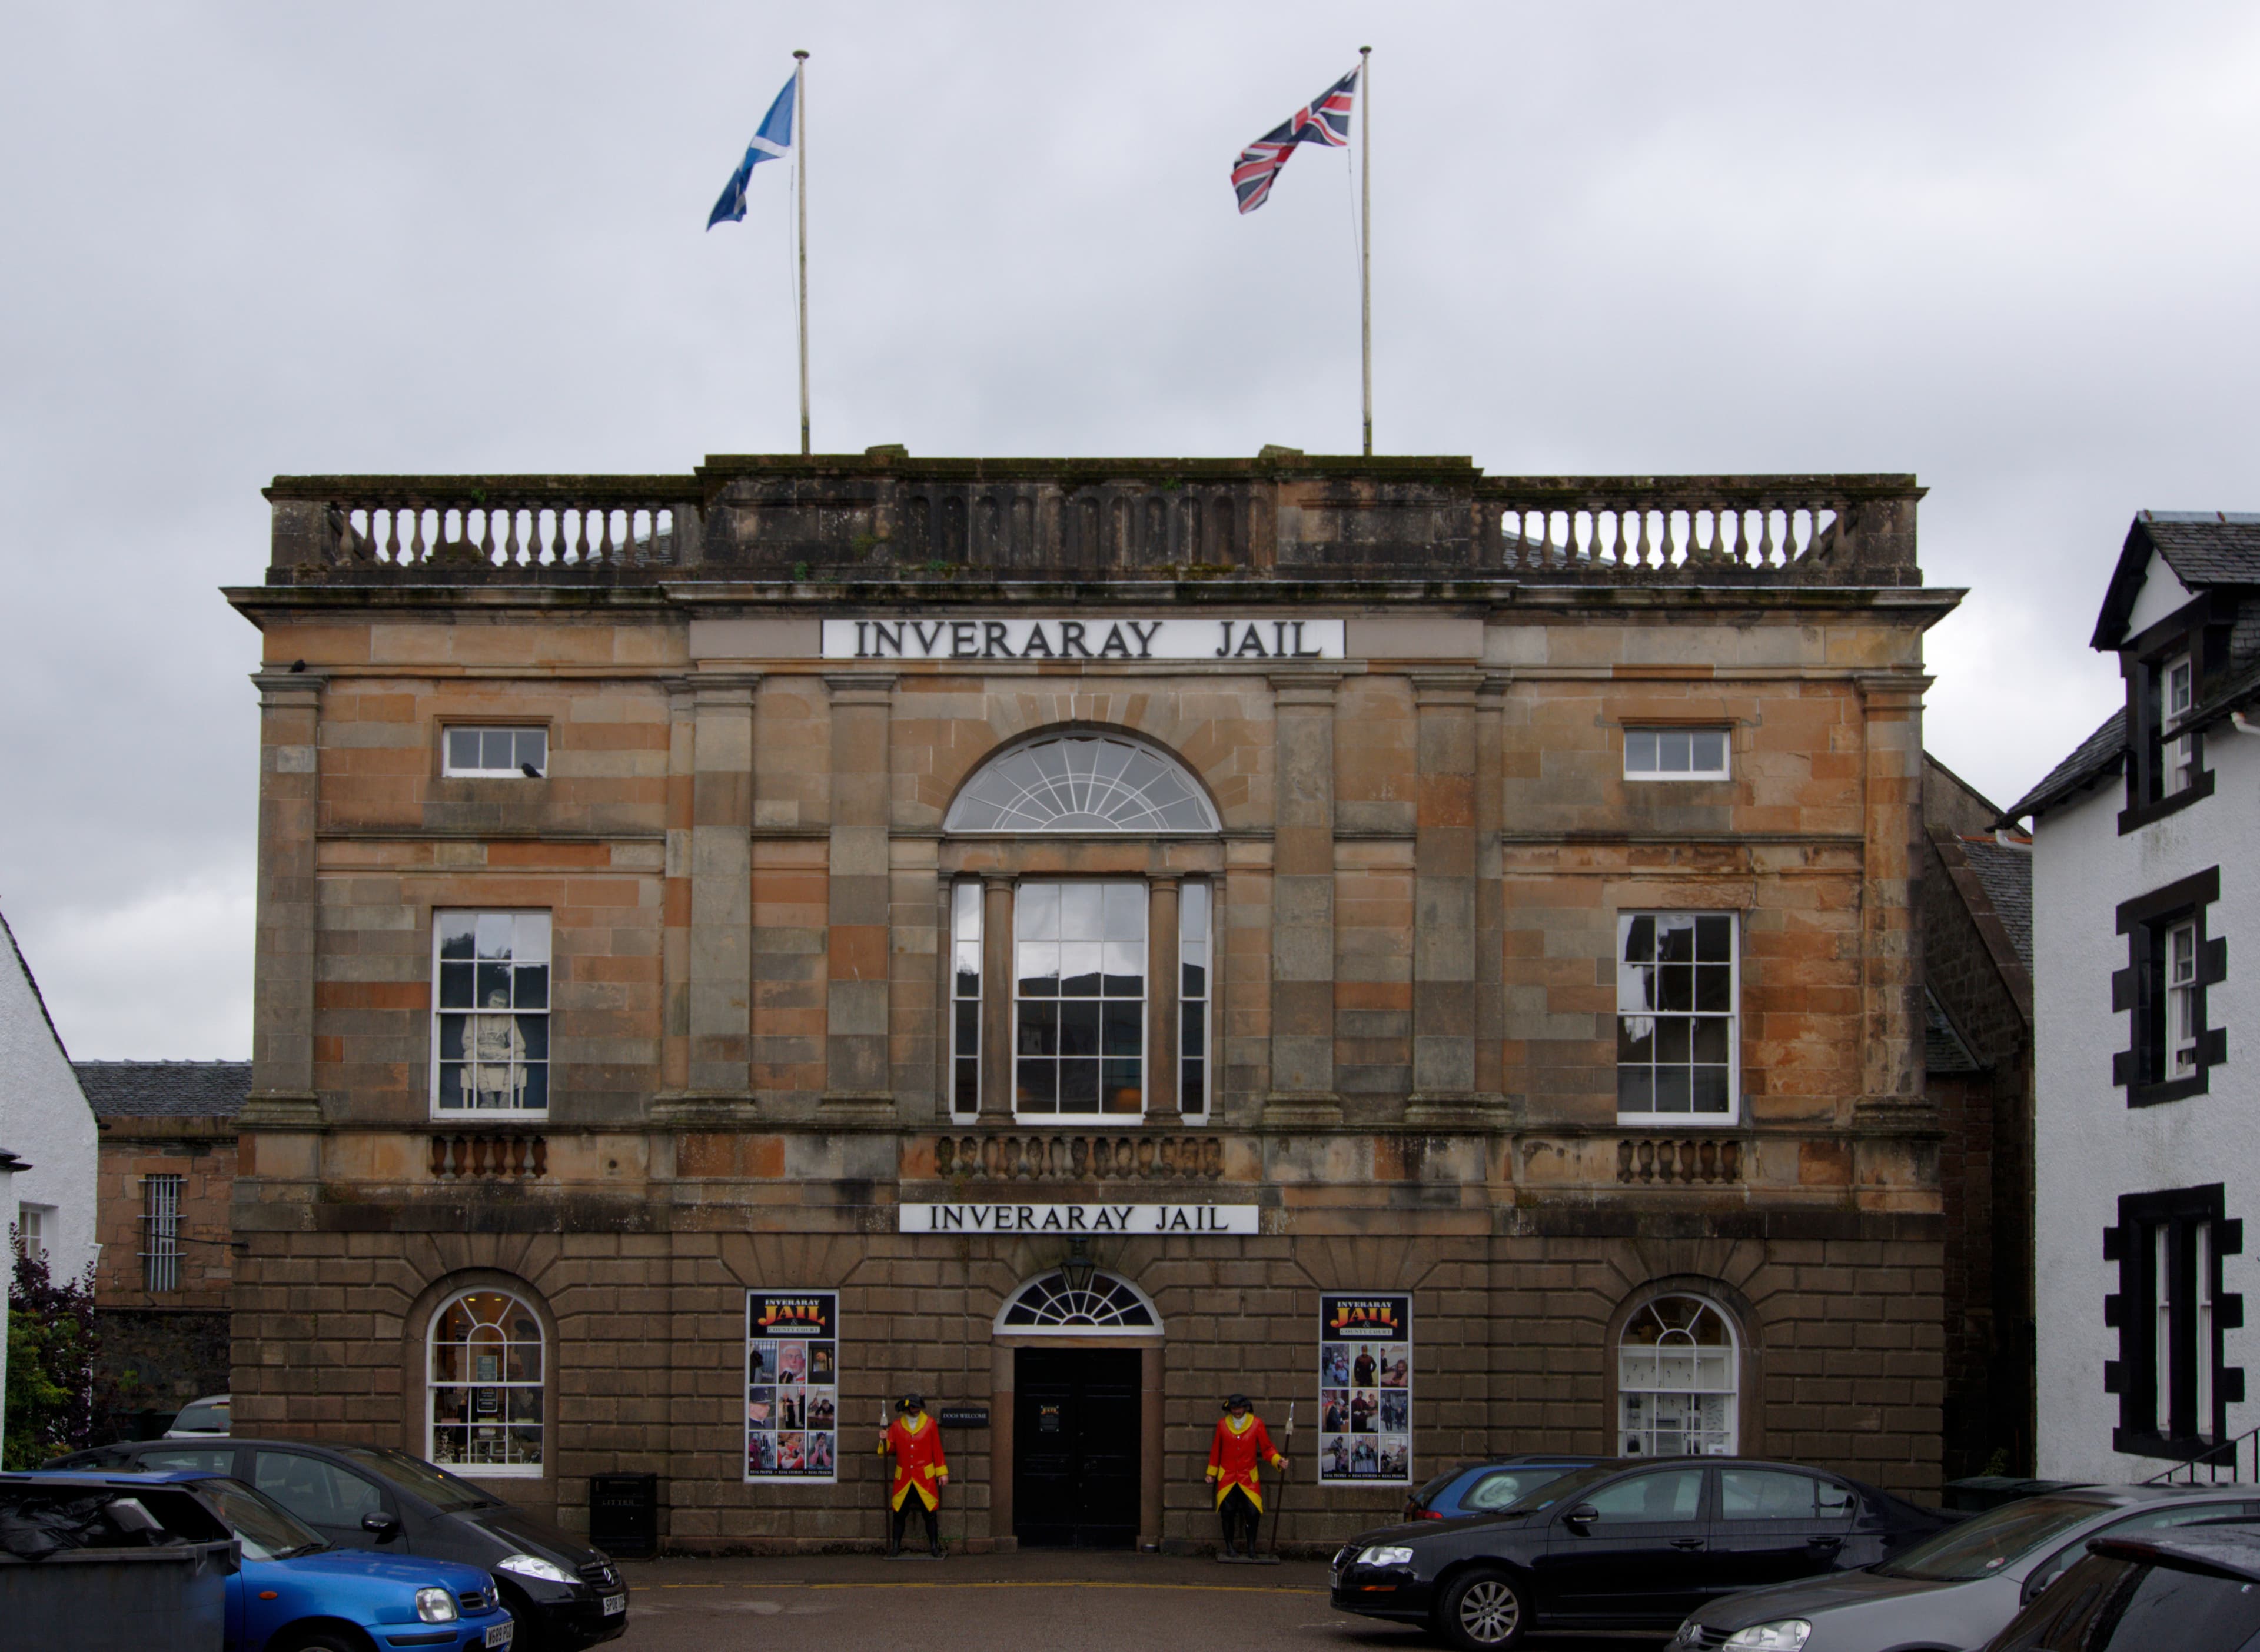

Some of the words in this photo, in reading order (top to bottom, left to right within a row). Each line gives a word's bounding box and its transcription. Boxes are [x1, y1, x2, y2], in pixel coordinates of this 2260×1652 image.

[855, 621, 1163, 657] INVERARAY
[1215, 621, 1322, 657] JAIL
[929, 1205, 1134, 1231] INVERARAY
[1155, 1206, 1229, 1231] JAIL
[757, 1305, 826, 1327] JAIL
[1330, 1307, 1398, 1328] JAIL
[488, 1626, 502, 1646] W689
